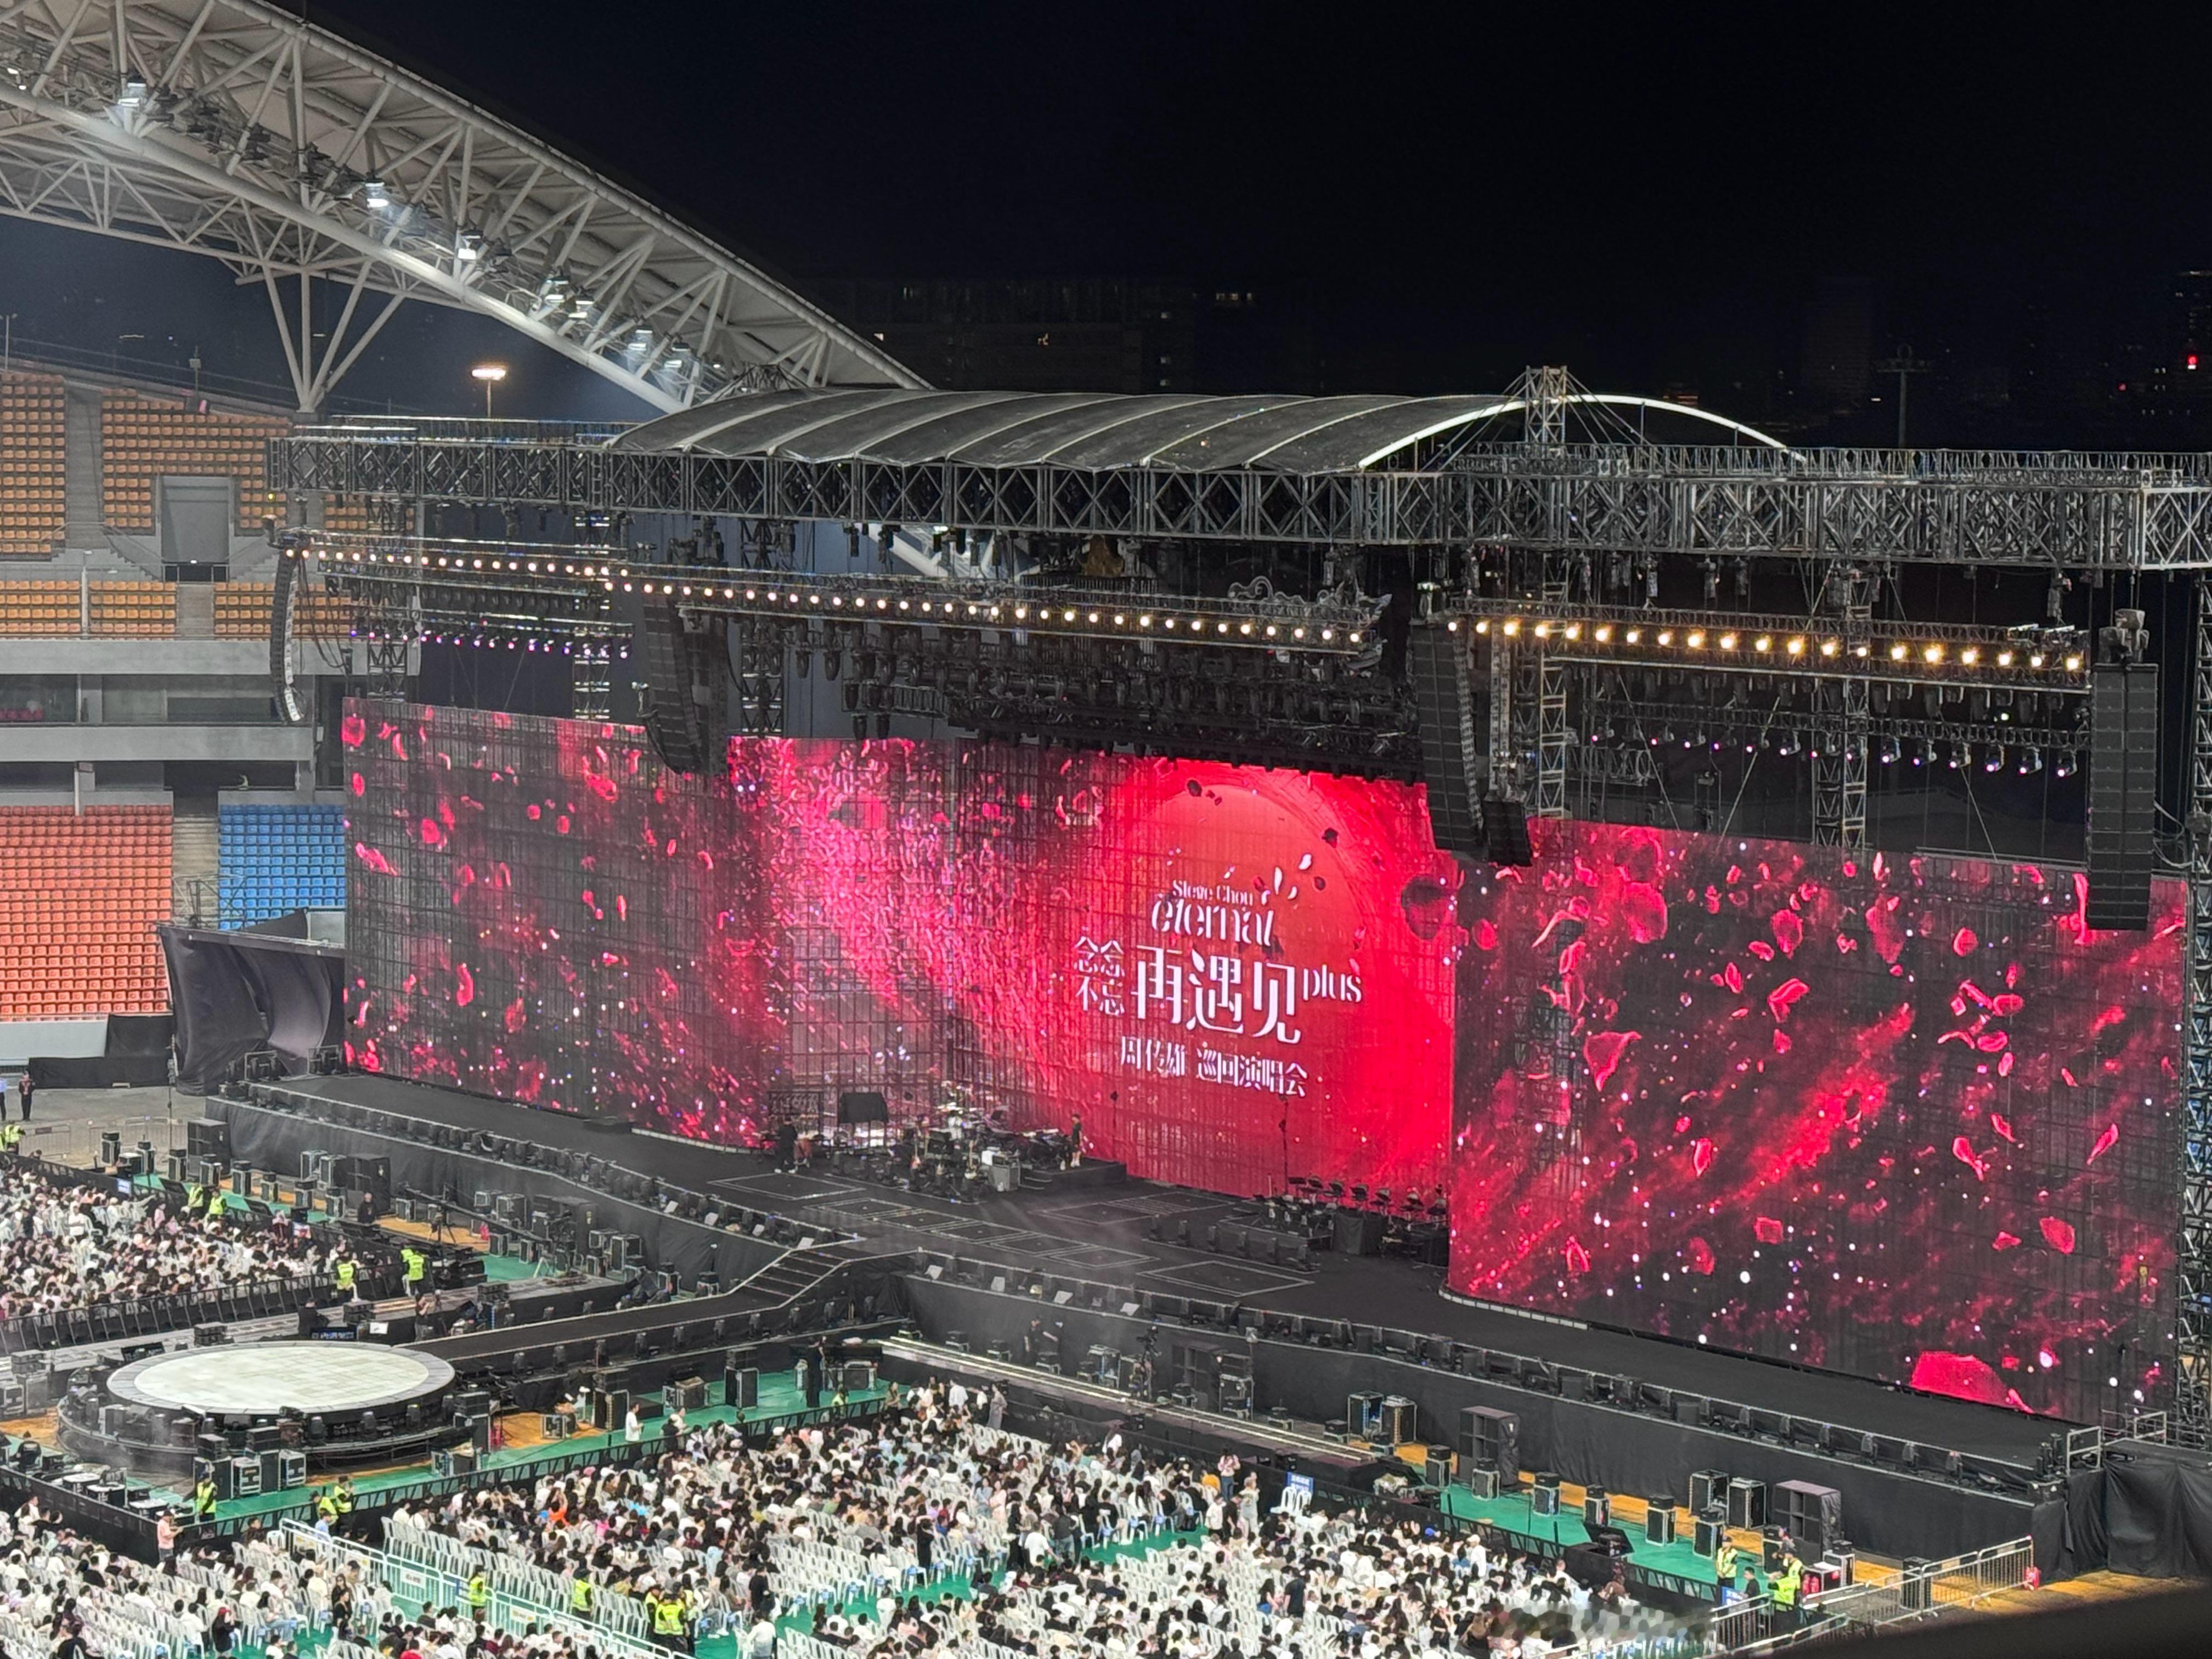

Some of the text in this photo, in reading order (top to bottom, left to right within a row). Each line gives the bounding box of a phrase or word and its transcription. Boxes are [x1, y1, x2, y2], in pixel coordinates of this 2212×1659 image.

[1172, 879, 1253, 906] Steve Chou
[1152, 899, 1274, 946] eternal
[1074, 936, 1125, 978] 念念
[1074, 974, 1125, 1015] 不忘
[1130, 945, 1301, 1044] 再遇见
[1303, 964, 1362, 1002] plus
